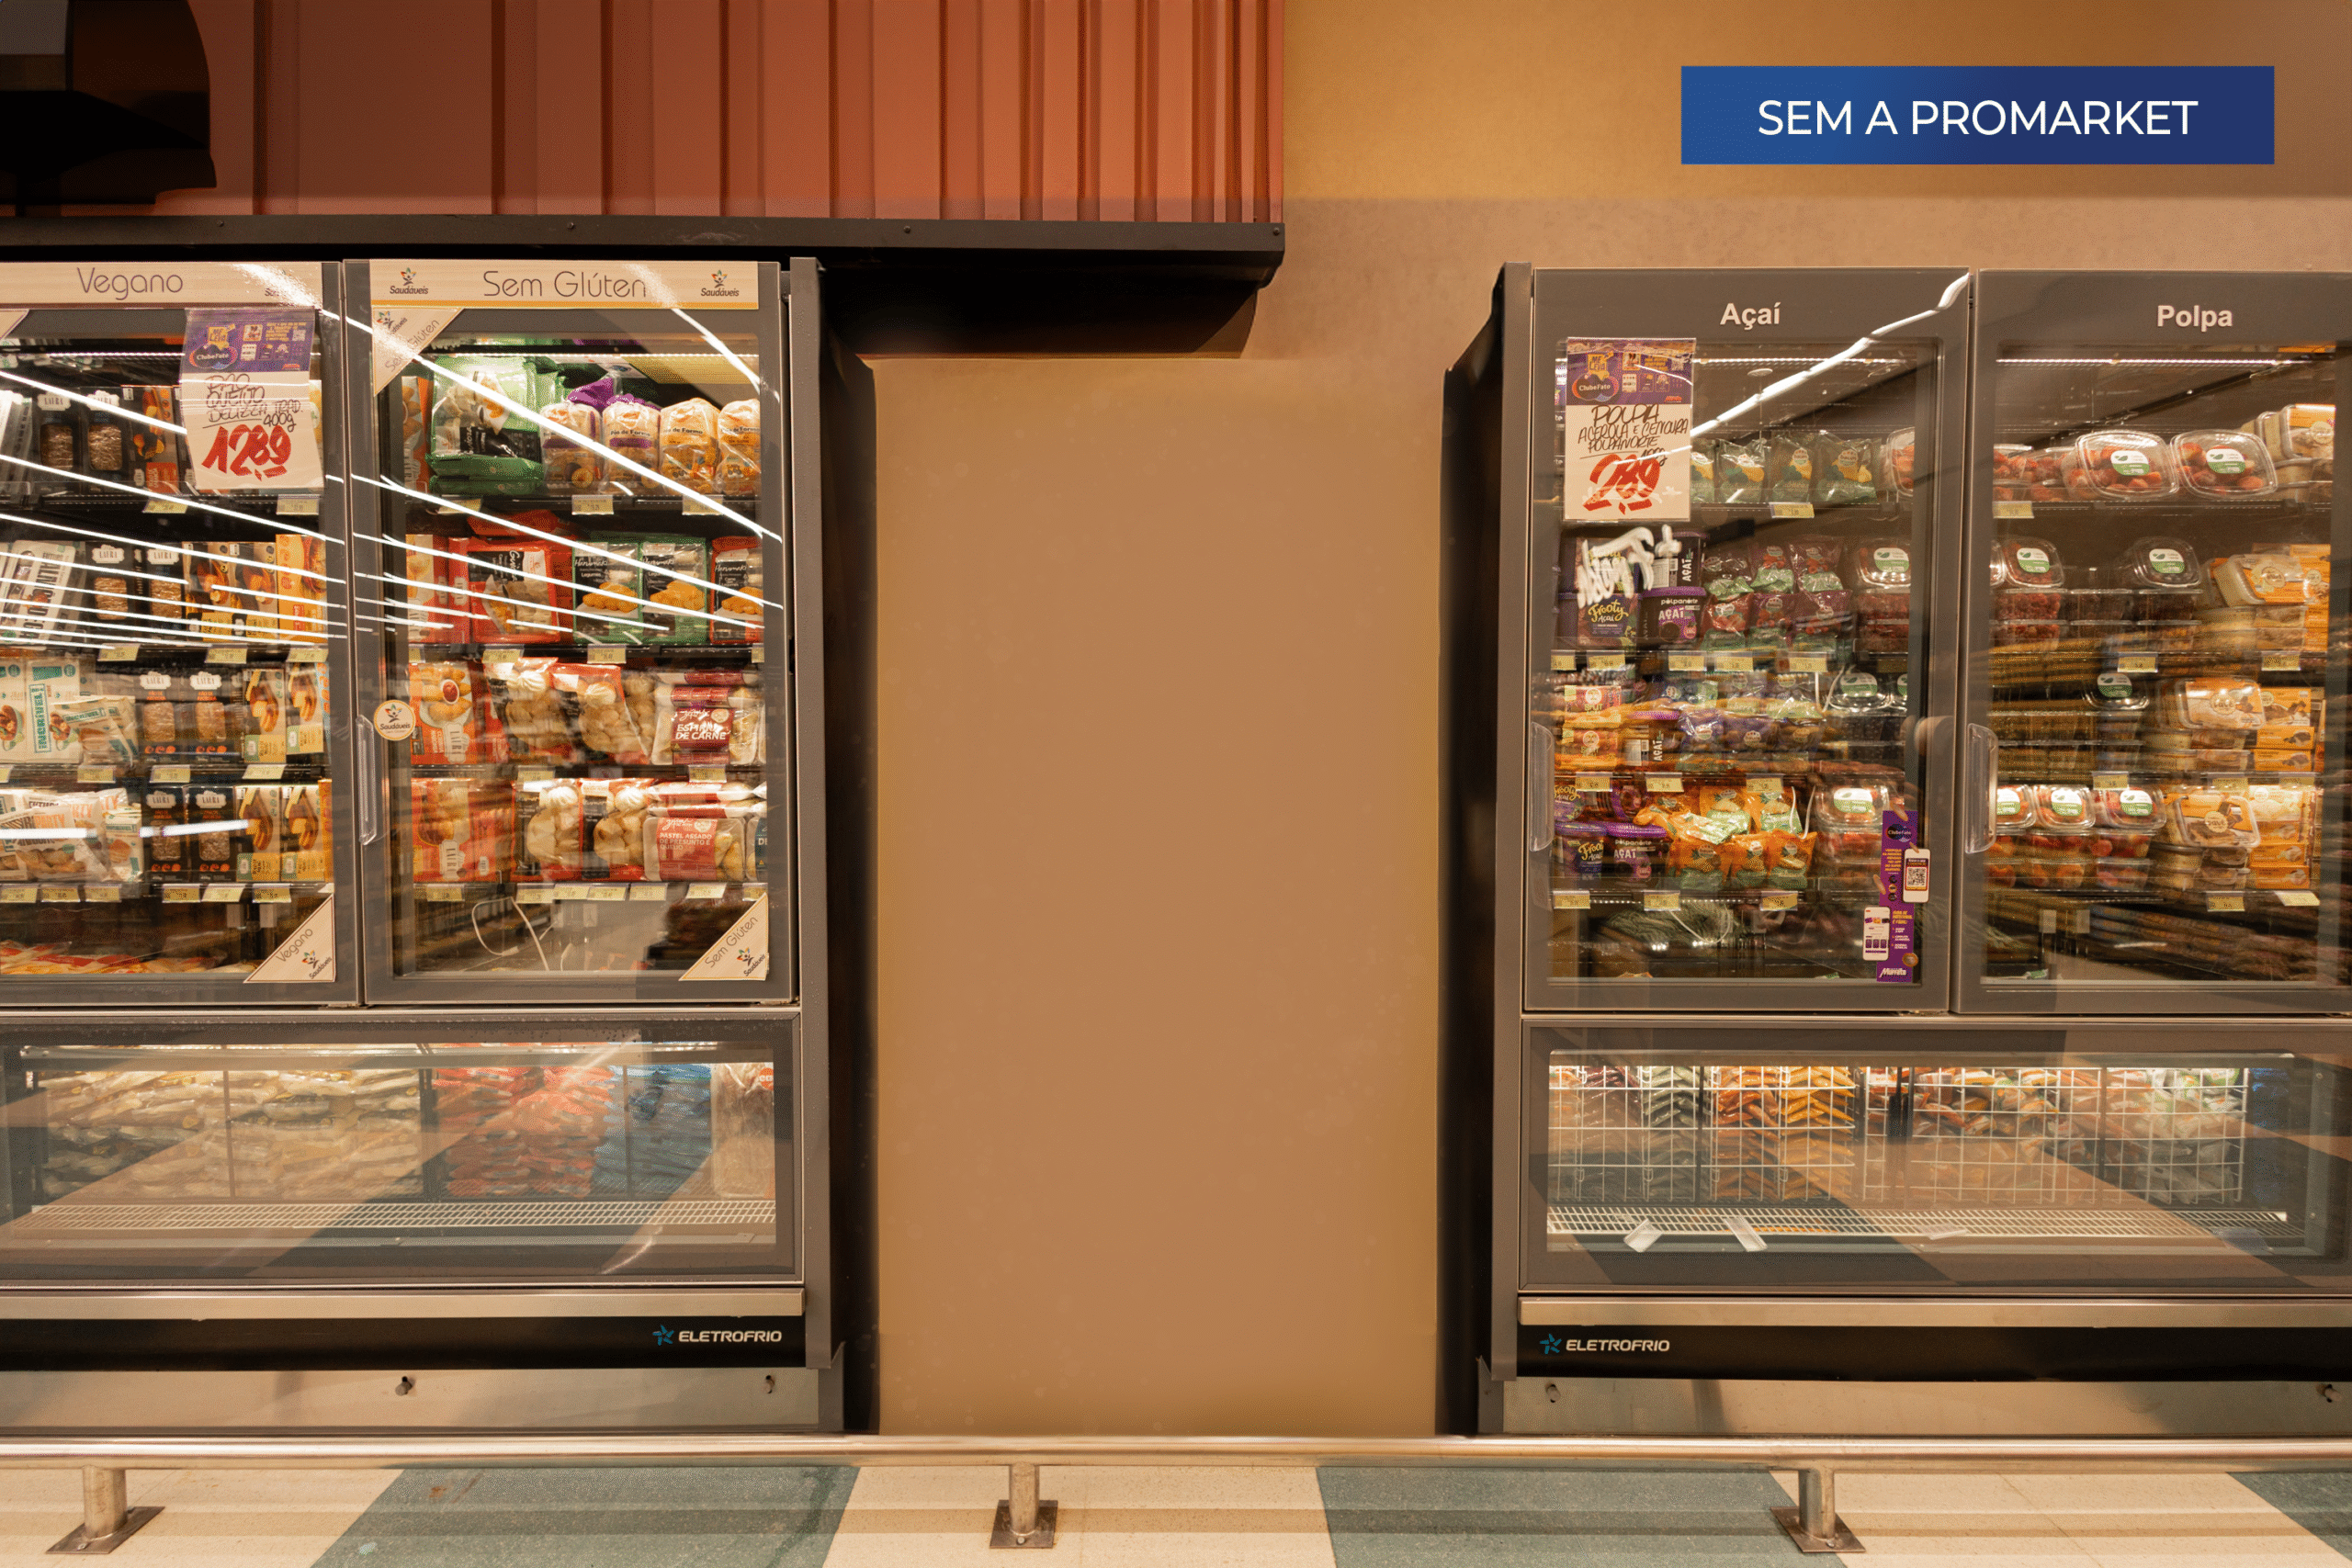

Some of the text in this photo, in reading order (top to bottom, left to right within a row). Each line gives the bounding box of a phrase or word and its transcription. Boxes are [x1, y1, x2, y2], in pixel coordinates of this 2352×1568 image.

[77, 267, 184, 299] Vegano
[389, 284, 429, 295] Saudáveis
[482, 270, 646, 299] Sem Glúten
[700, 286, 741, 299] Saudáveis
[1720, 302, 1781, 331] Açaí
[2157, 305, 2233, 332] Polpa
[1578, 383, 1611, 391] ClubeFato
[263, 413, 297, 433] 400g
[1681, 558, 1692, 582] AÇAÍ
[1588, 600, 1629, 624] Frooty
[1658, 608, 1685, 621] AÇAÍ
[379, 722, 412, 731] Saudáveis
[675, 731, 726, 740] DE CARNE
[276, 926, 314, 964] Vegano
[704, 913, 760, 970] Sem Glúten
[308, 955, 334, 981] Saudáveis
[678, 1331, 782, 1342] ELETROFRIO
[1566, 1339, 1670, 1351] ELETROFRIO
